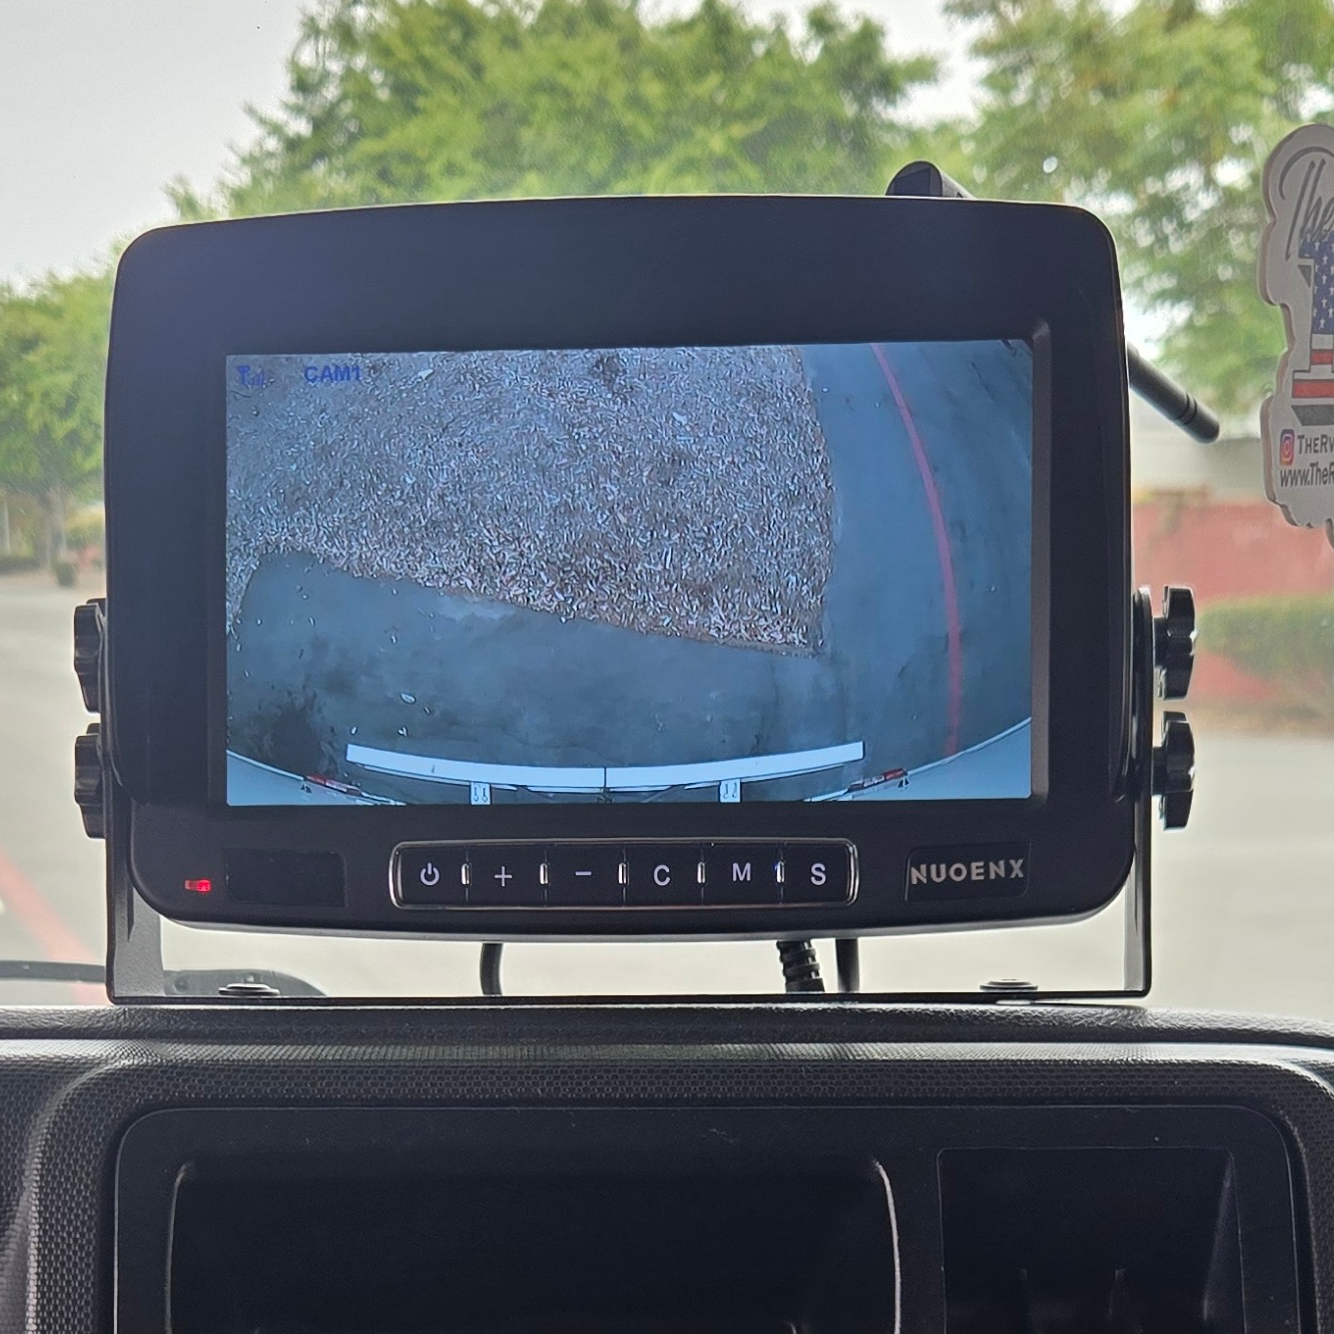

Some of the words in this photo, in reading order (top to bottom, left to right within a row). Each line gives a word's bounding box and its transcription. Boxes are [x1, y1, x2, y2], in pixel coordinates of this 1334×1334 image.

[304, 364, 361, 383] CAM1
[653, 864, 671, 886] C
[732, 862, 752, 881] M
[810, 863, 827, 886] S
[910, 858, 1024, 885] NUOENX
